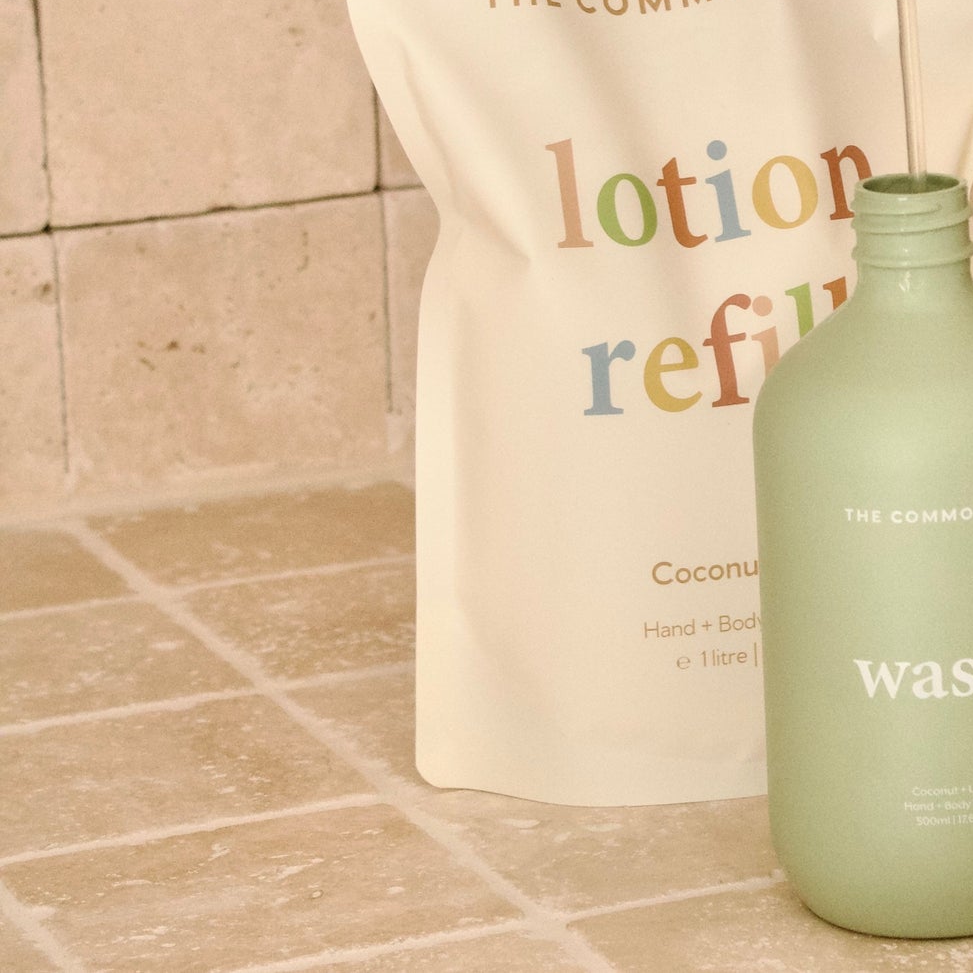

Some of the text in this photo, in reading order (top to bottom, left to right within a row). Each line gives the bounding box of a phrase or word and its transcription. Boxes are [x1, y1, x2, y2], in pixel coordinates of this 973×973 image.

[544, 137, 874, 249] lotion
[844, 507, 882, 524] THE
[651, 560, 759, 586] Coconu
[643, 618, 697, 639] Hand
[718, 611, 762, 633] Bod
[912, 786, 959, 797] Coconut
[904, 801, 935, 811] Hand
[944, 800, 972, 811] Body
